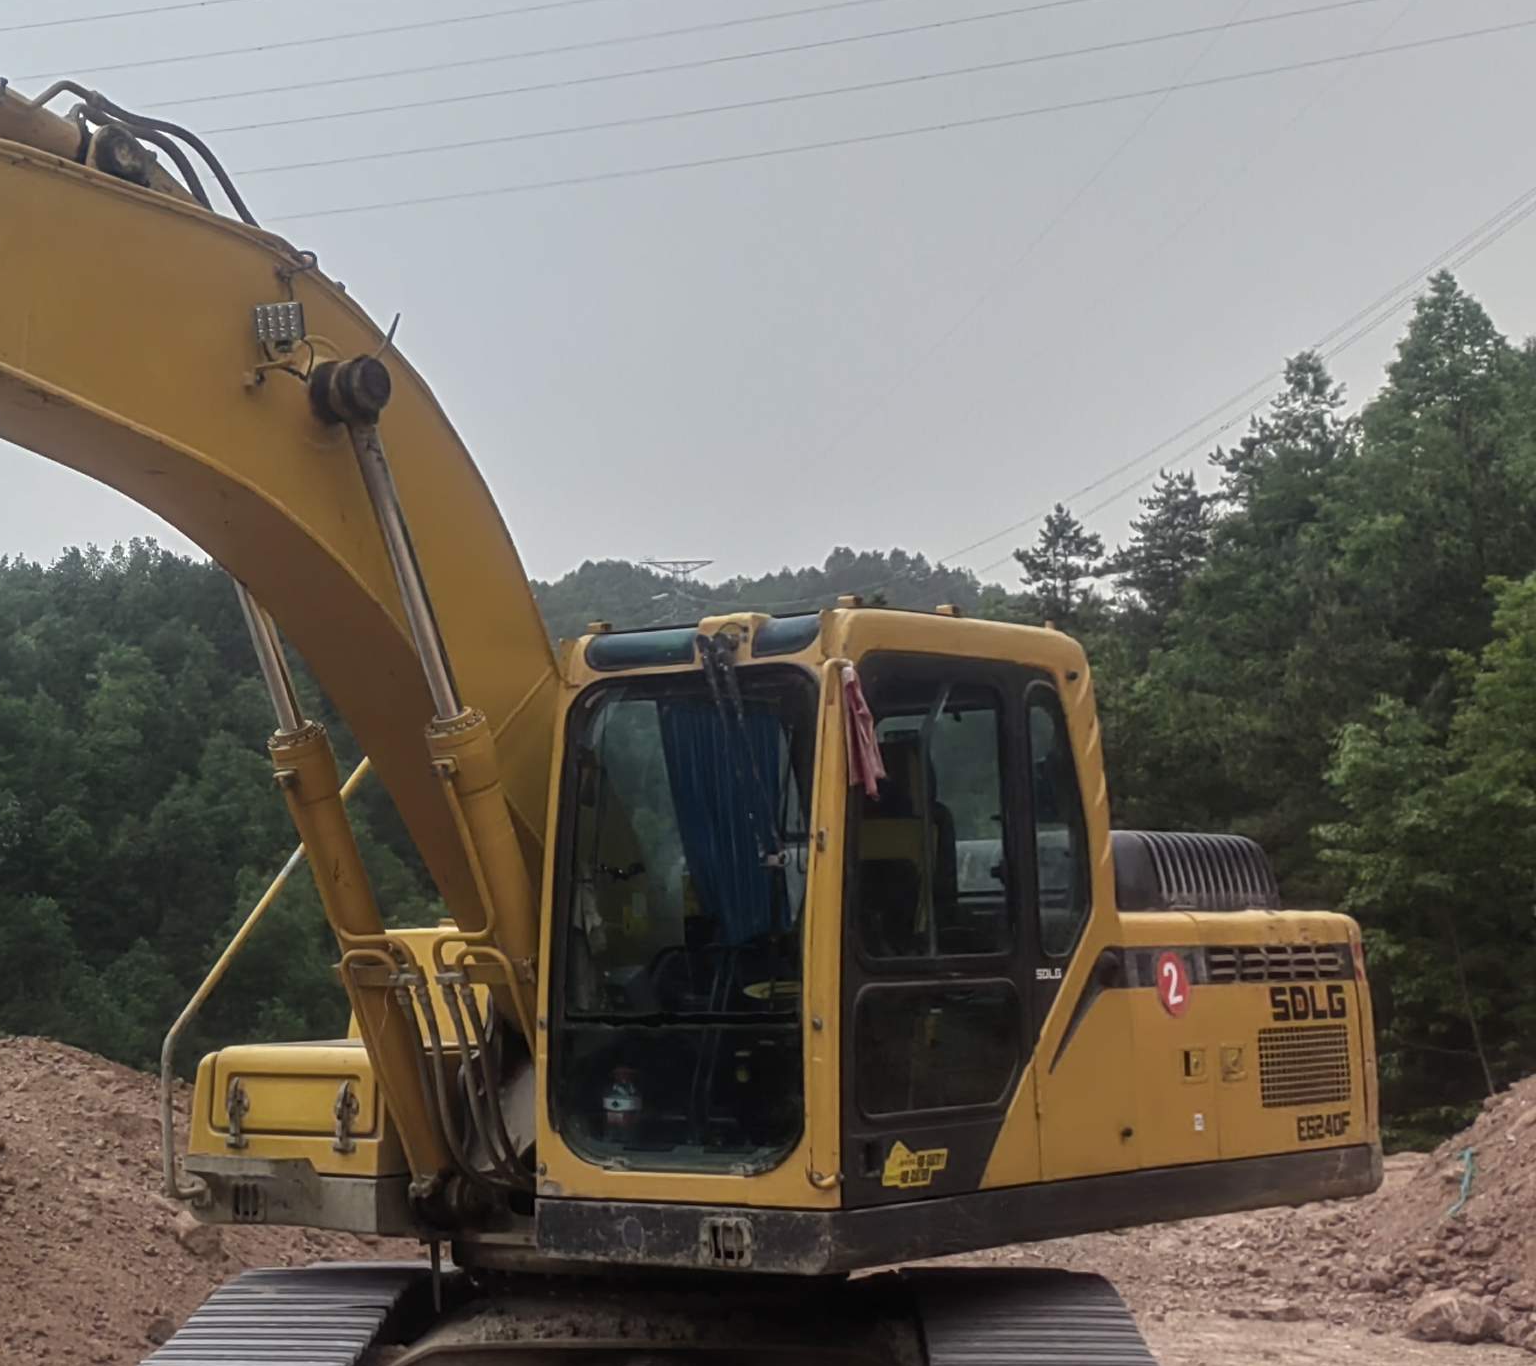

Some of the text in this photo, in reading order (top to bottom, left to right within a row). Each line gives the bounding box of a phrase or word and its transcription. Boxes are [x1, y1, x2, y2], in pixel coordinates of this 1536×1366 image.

[1036, 968, 1062, 979] SDLG
[1163, 962, 1183, 1005] 2
[1269, 986, 1346, 1021] SDLG
